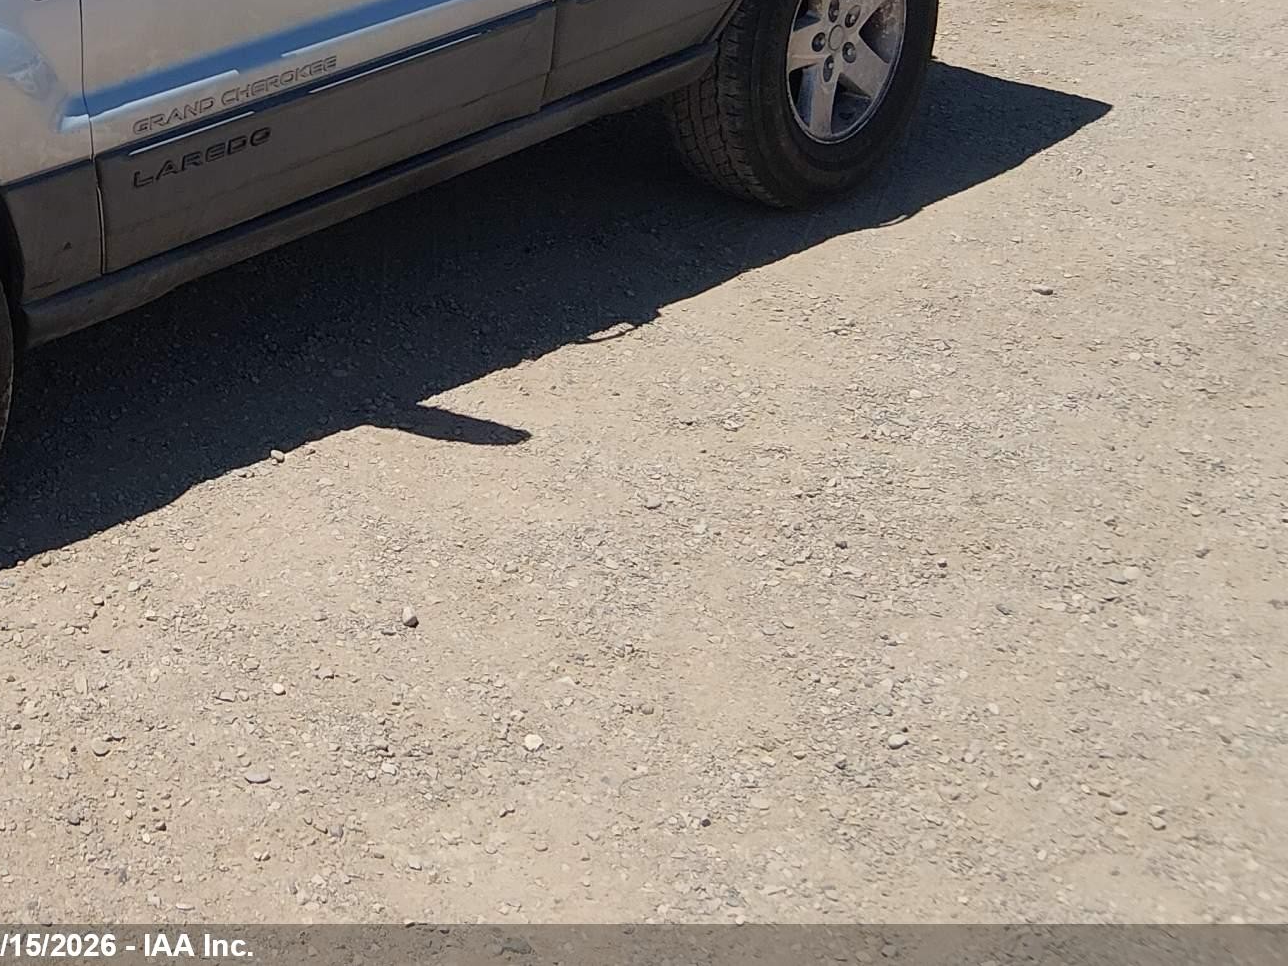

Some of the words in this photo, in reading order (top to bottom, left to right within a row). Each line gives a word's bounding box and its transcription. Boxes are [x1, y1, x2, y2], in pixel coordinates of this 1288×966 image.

[133, 98, 214, 134] GRAND
[221, 55, 337, 107] CHEROKEE
[133, 127, 272, 187] LAREDO
